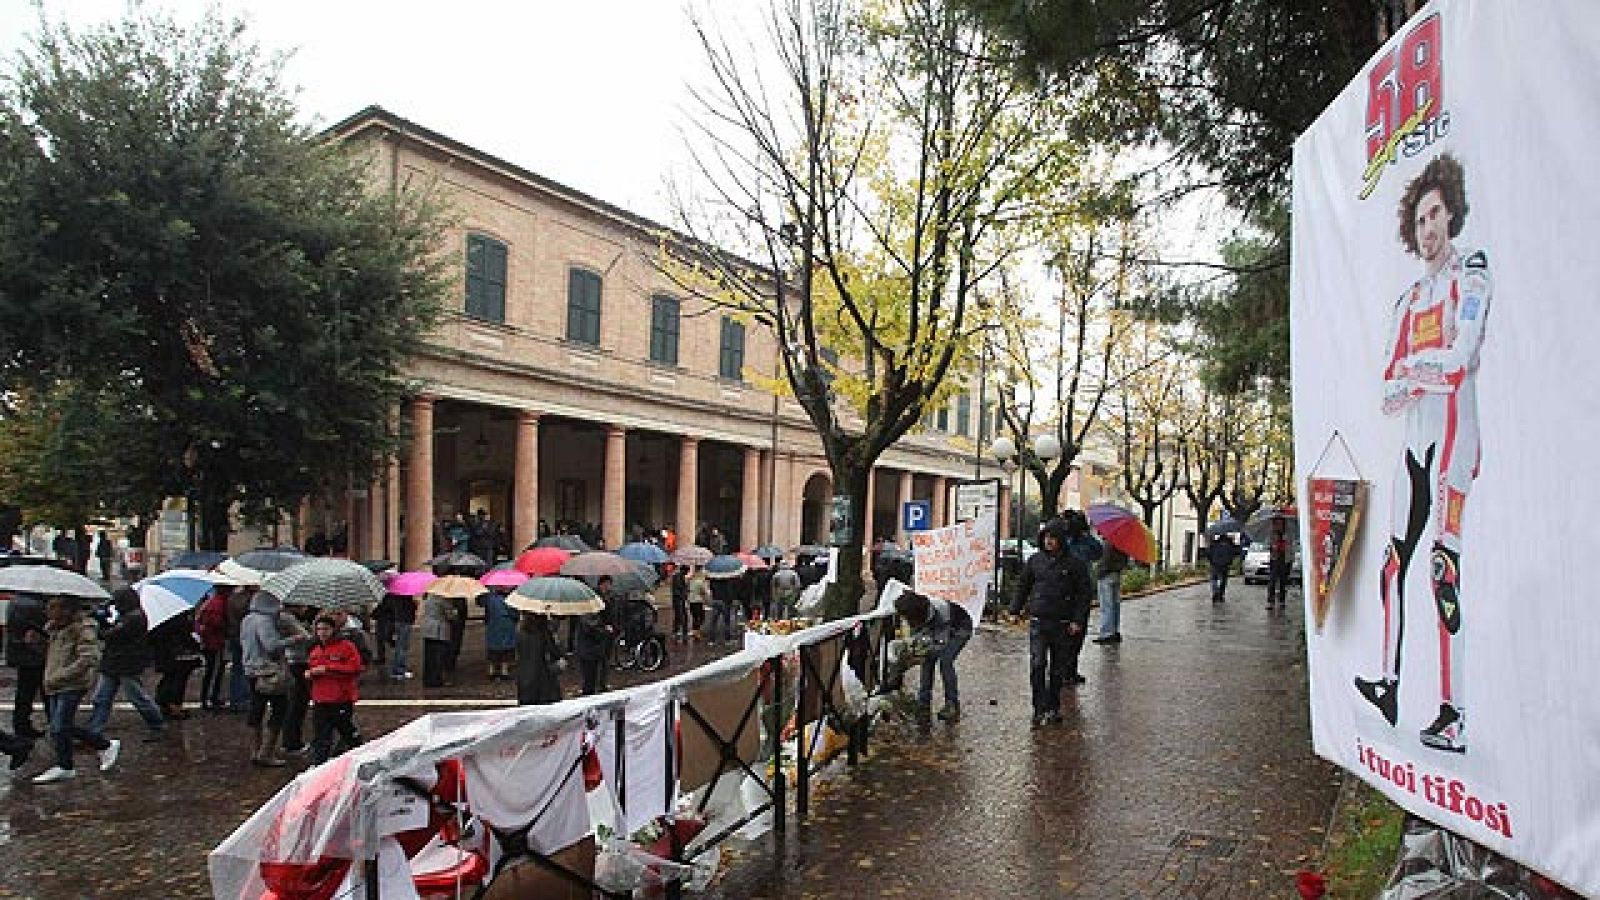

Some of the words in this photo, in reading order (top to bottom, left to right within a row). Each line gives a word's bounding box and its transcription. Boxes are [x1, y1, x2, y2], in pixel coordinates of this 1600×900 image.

[1365, 12, 1441, 165] 58
[909, 506, 923, 528] P
[1367, 746, 1417, 794] tuoi
[1422, 773, 1514, 839] tifosi
